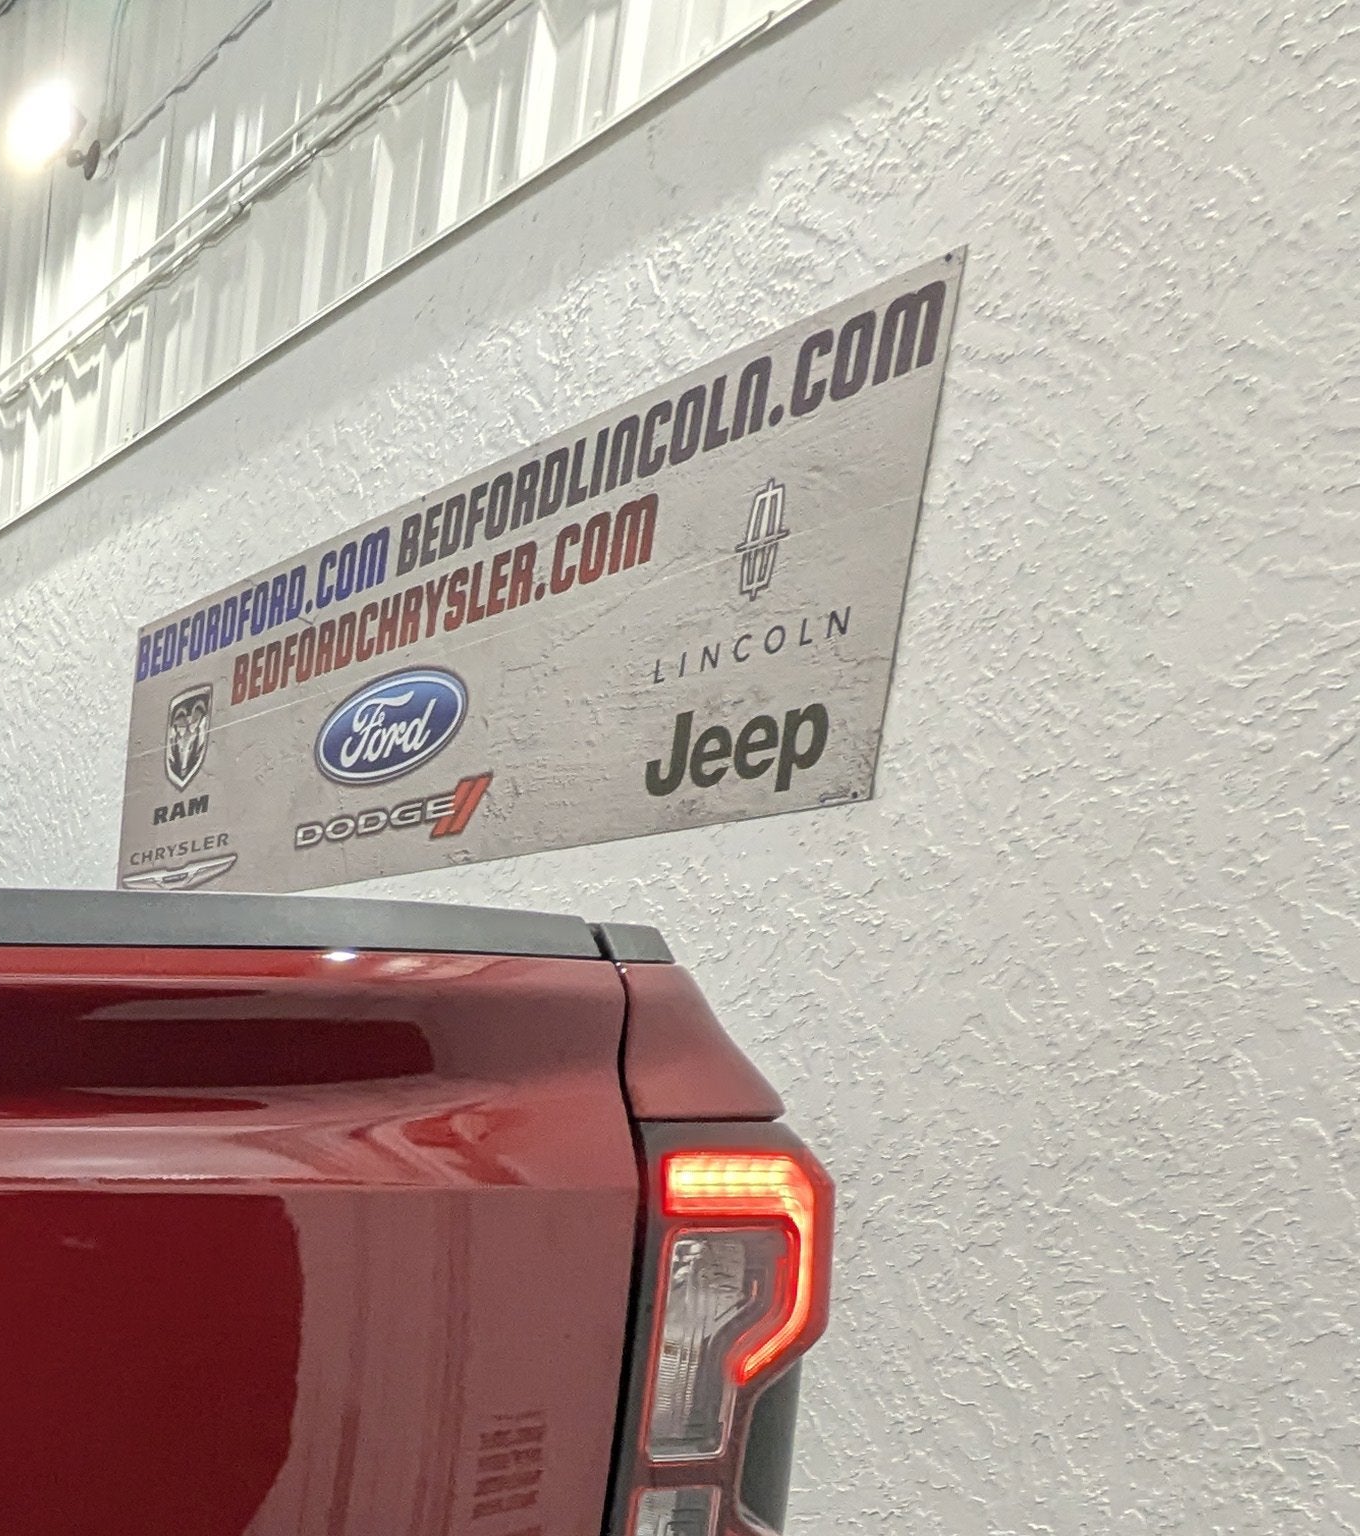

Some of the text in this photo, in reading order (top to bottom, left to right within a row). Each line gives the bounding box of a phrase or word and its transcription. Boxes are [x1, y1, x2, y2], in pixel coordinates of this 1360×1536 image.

[136, 279, 948, 683] BEDFORDFORD.COM BEDFORDLINCOLN.COM
[230, 492, 660, 706] BEDFORDCHRYSLER.COM
[653, 605, 852, 685] LINCOLN
[339, 689, 434, 769] Ford
[644, 702, 830, 797] Jeep
[129, 832, 230, 867] CHRYSLER
[152, 794, 210, 826] RAM
[294, 793, 457, 850] DODGE
